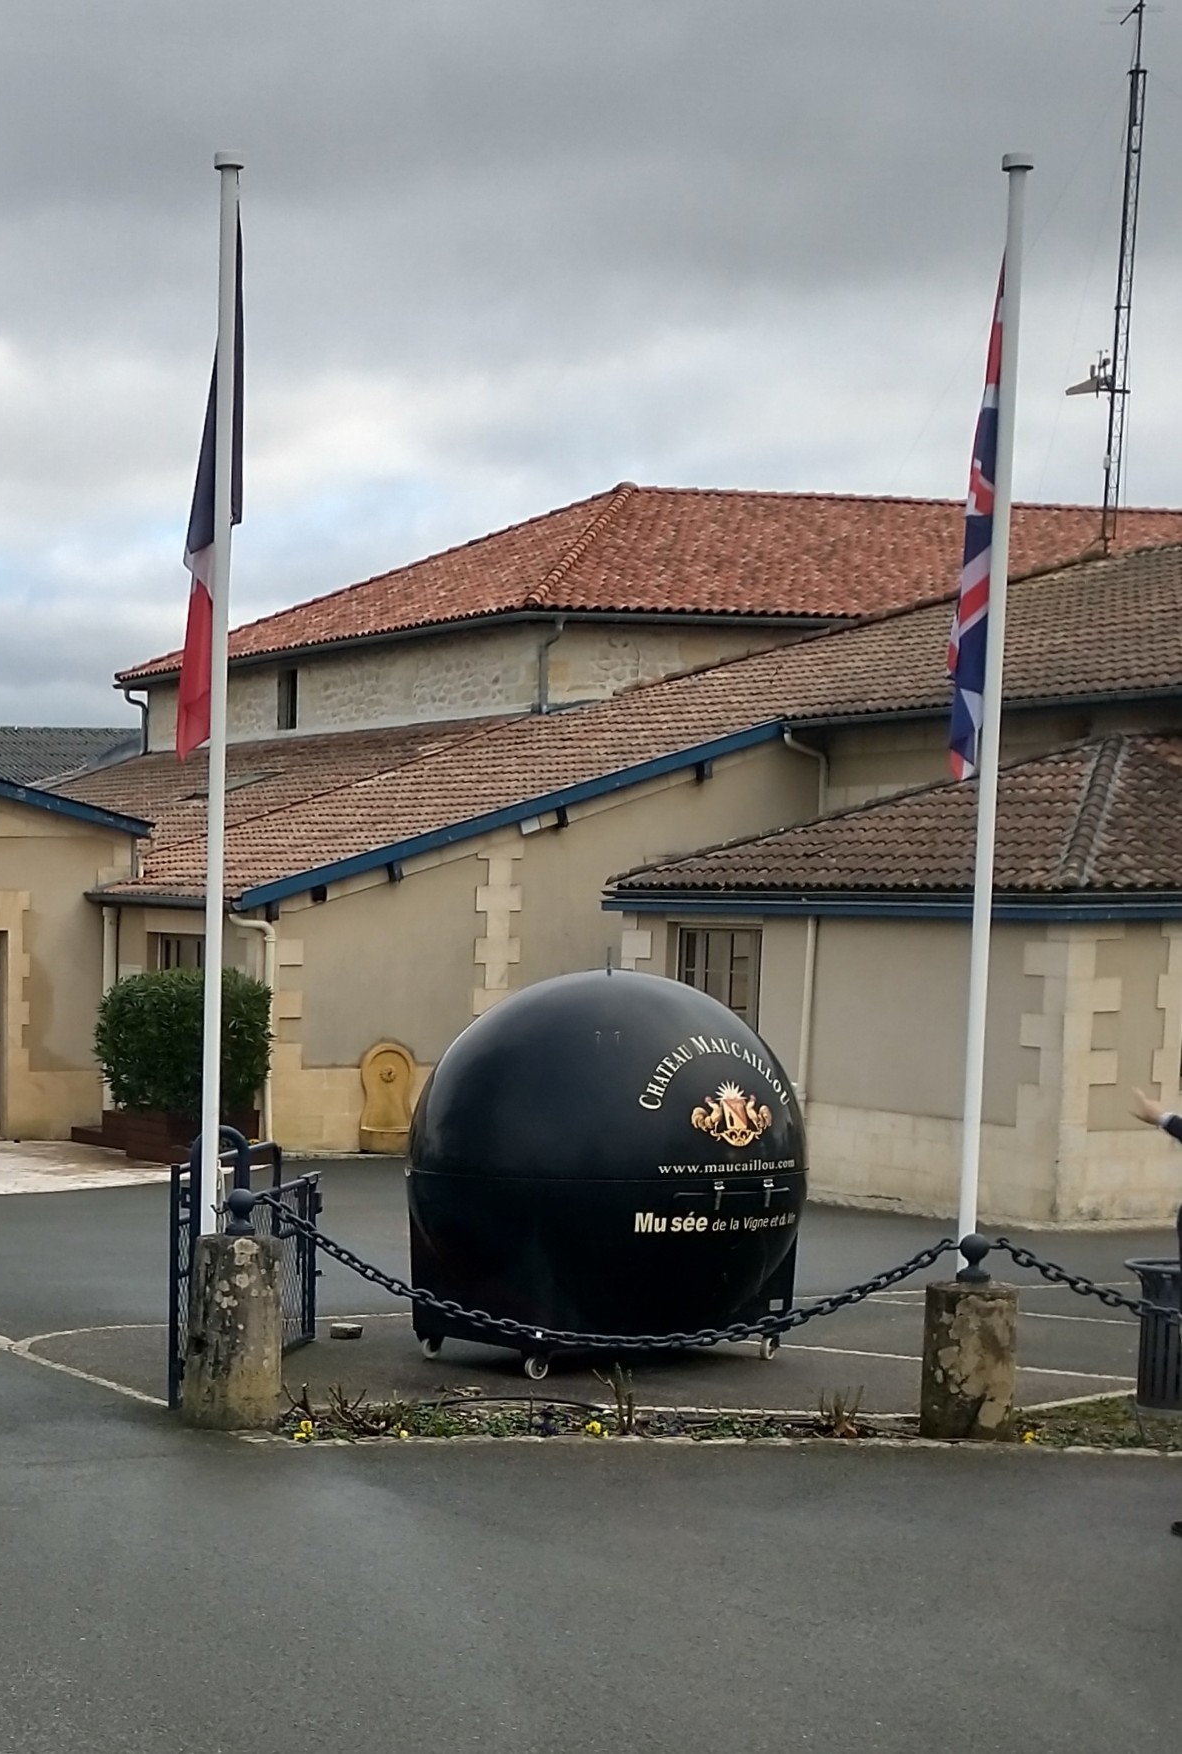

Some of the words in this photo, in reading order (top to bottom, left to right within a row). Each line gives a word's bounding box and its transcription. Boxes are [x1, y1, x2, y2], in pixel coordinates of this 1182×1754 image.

[639, 1043, 694, 1110] CHATEAU
[690, 1035, 791, 1106] MAUCAILLOU
[658, 1158, 795, 1174] www.maucaillou.com
[712, 1217, 727, 1231] de
[729, 1217, 740, 1231] la
[743, 1216, 769, 1231] Vigne
